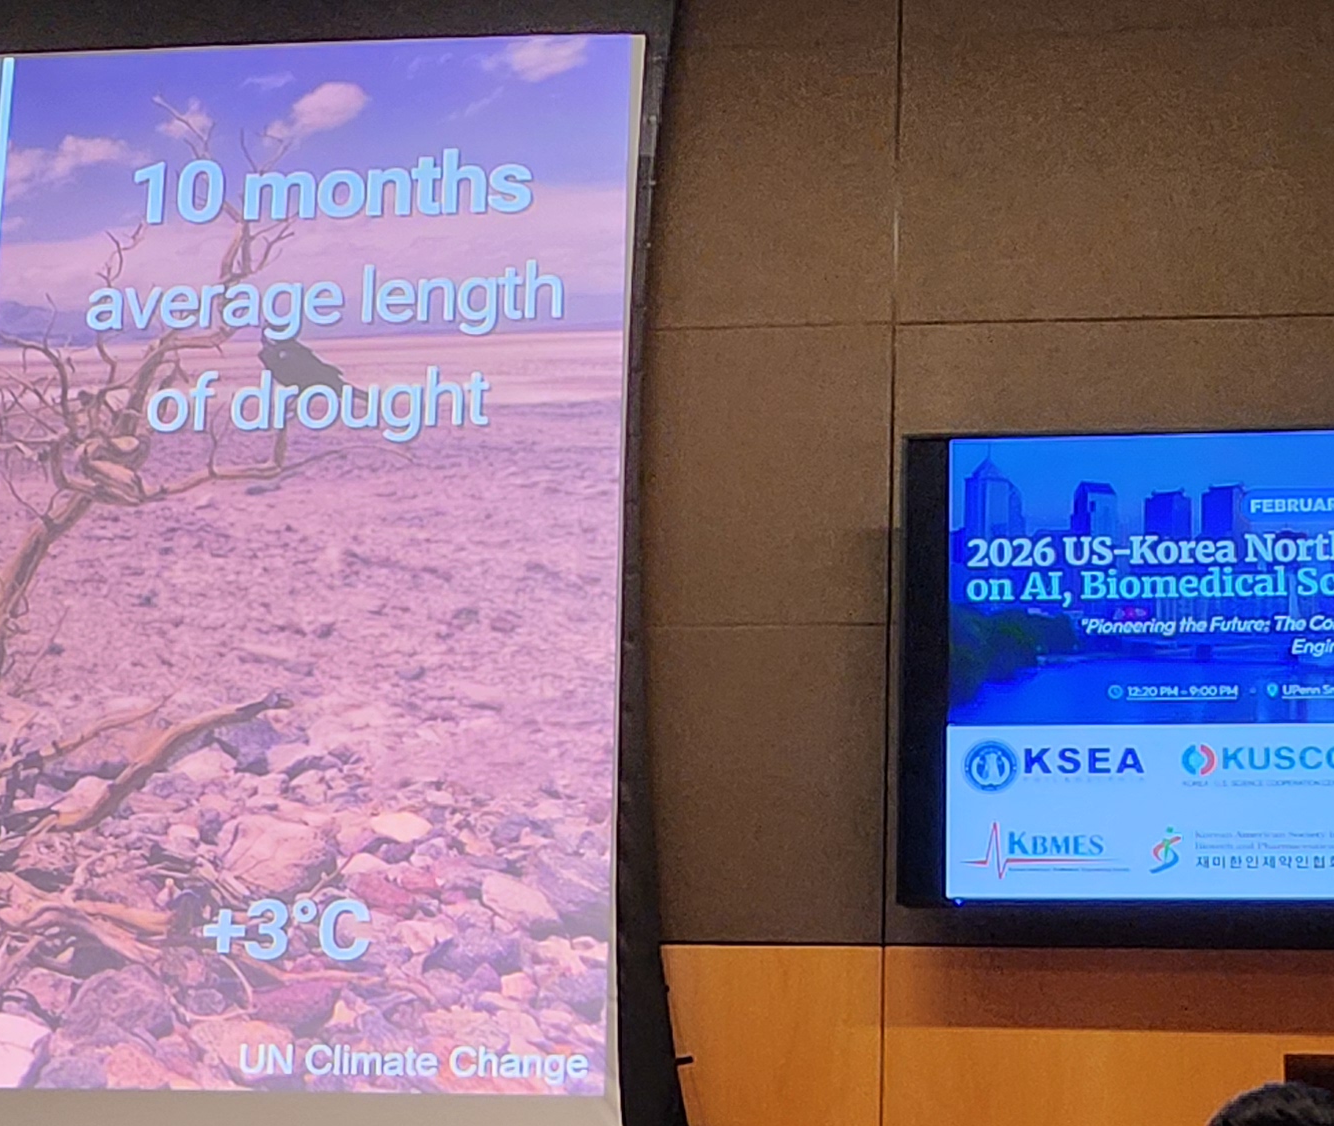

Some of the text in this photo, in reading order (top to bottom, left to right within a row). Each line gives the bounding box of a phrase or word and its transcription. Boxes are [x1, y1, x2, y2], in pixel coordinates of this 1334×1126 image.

[133, 147, 533, 225] 10 months
[85, 259, 564, 341] average length
[147, 366, 490, 443] of drought
[966, 536, 1056, 567] 2026
[1063, 534, 1237, 566] US-Korea
[966, 577, 1015, 601] on
[1020, 571, 1074, 608] AI,
[1081, 565, 1287, 601] Biomedical
[1179, 616, 1208, 633] the
[1274, 615, 1308, 632] The
[1160, 685, 1178, 697] PM
[1190, 685, 1217, 697] 9:00
[1023, 747, 1145, 774] KSEA
[1008, 830, 1105, 856] KBMES
[202, 898, 371, 961] +3°C
[238, 1043, 590, 1083] UN Climate Change
